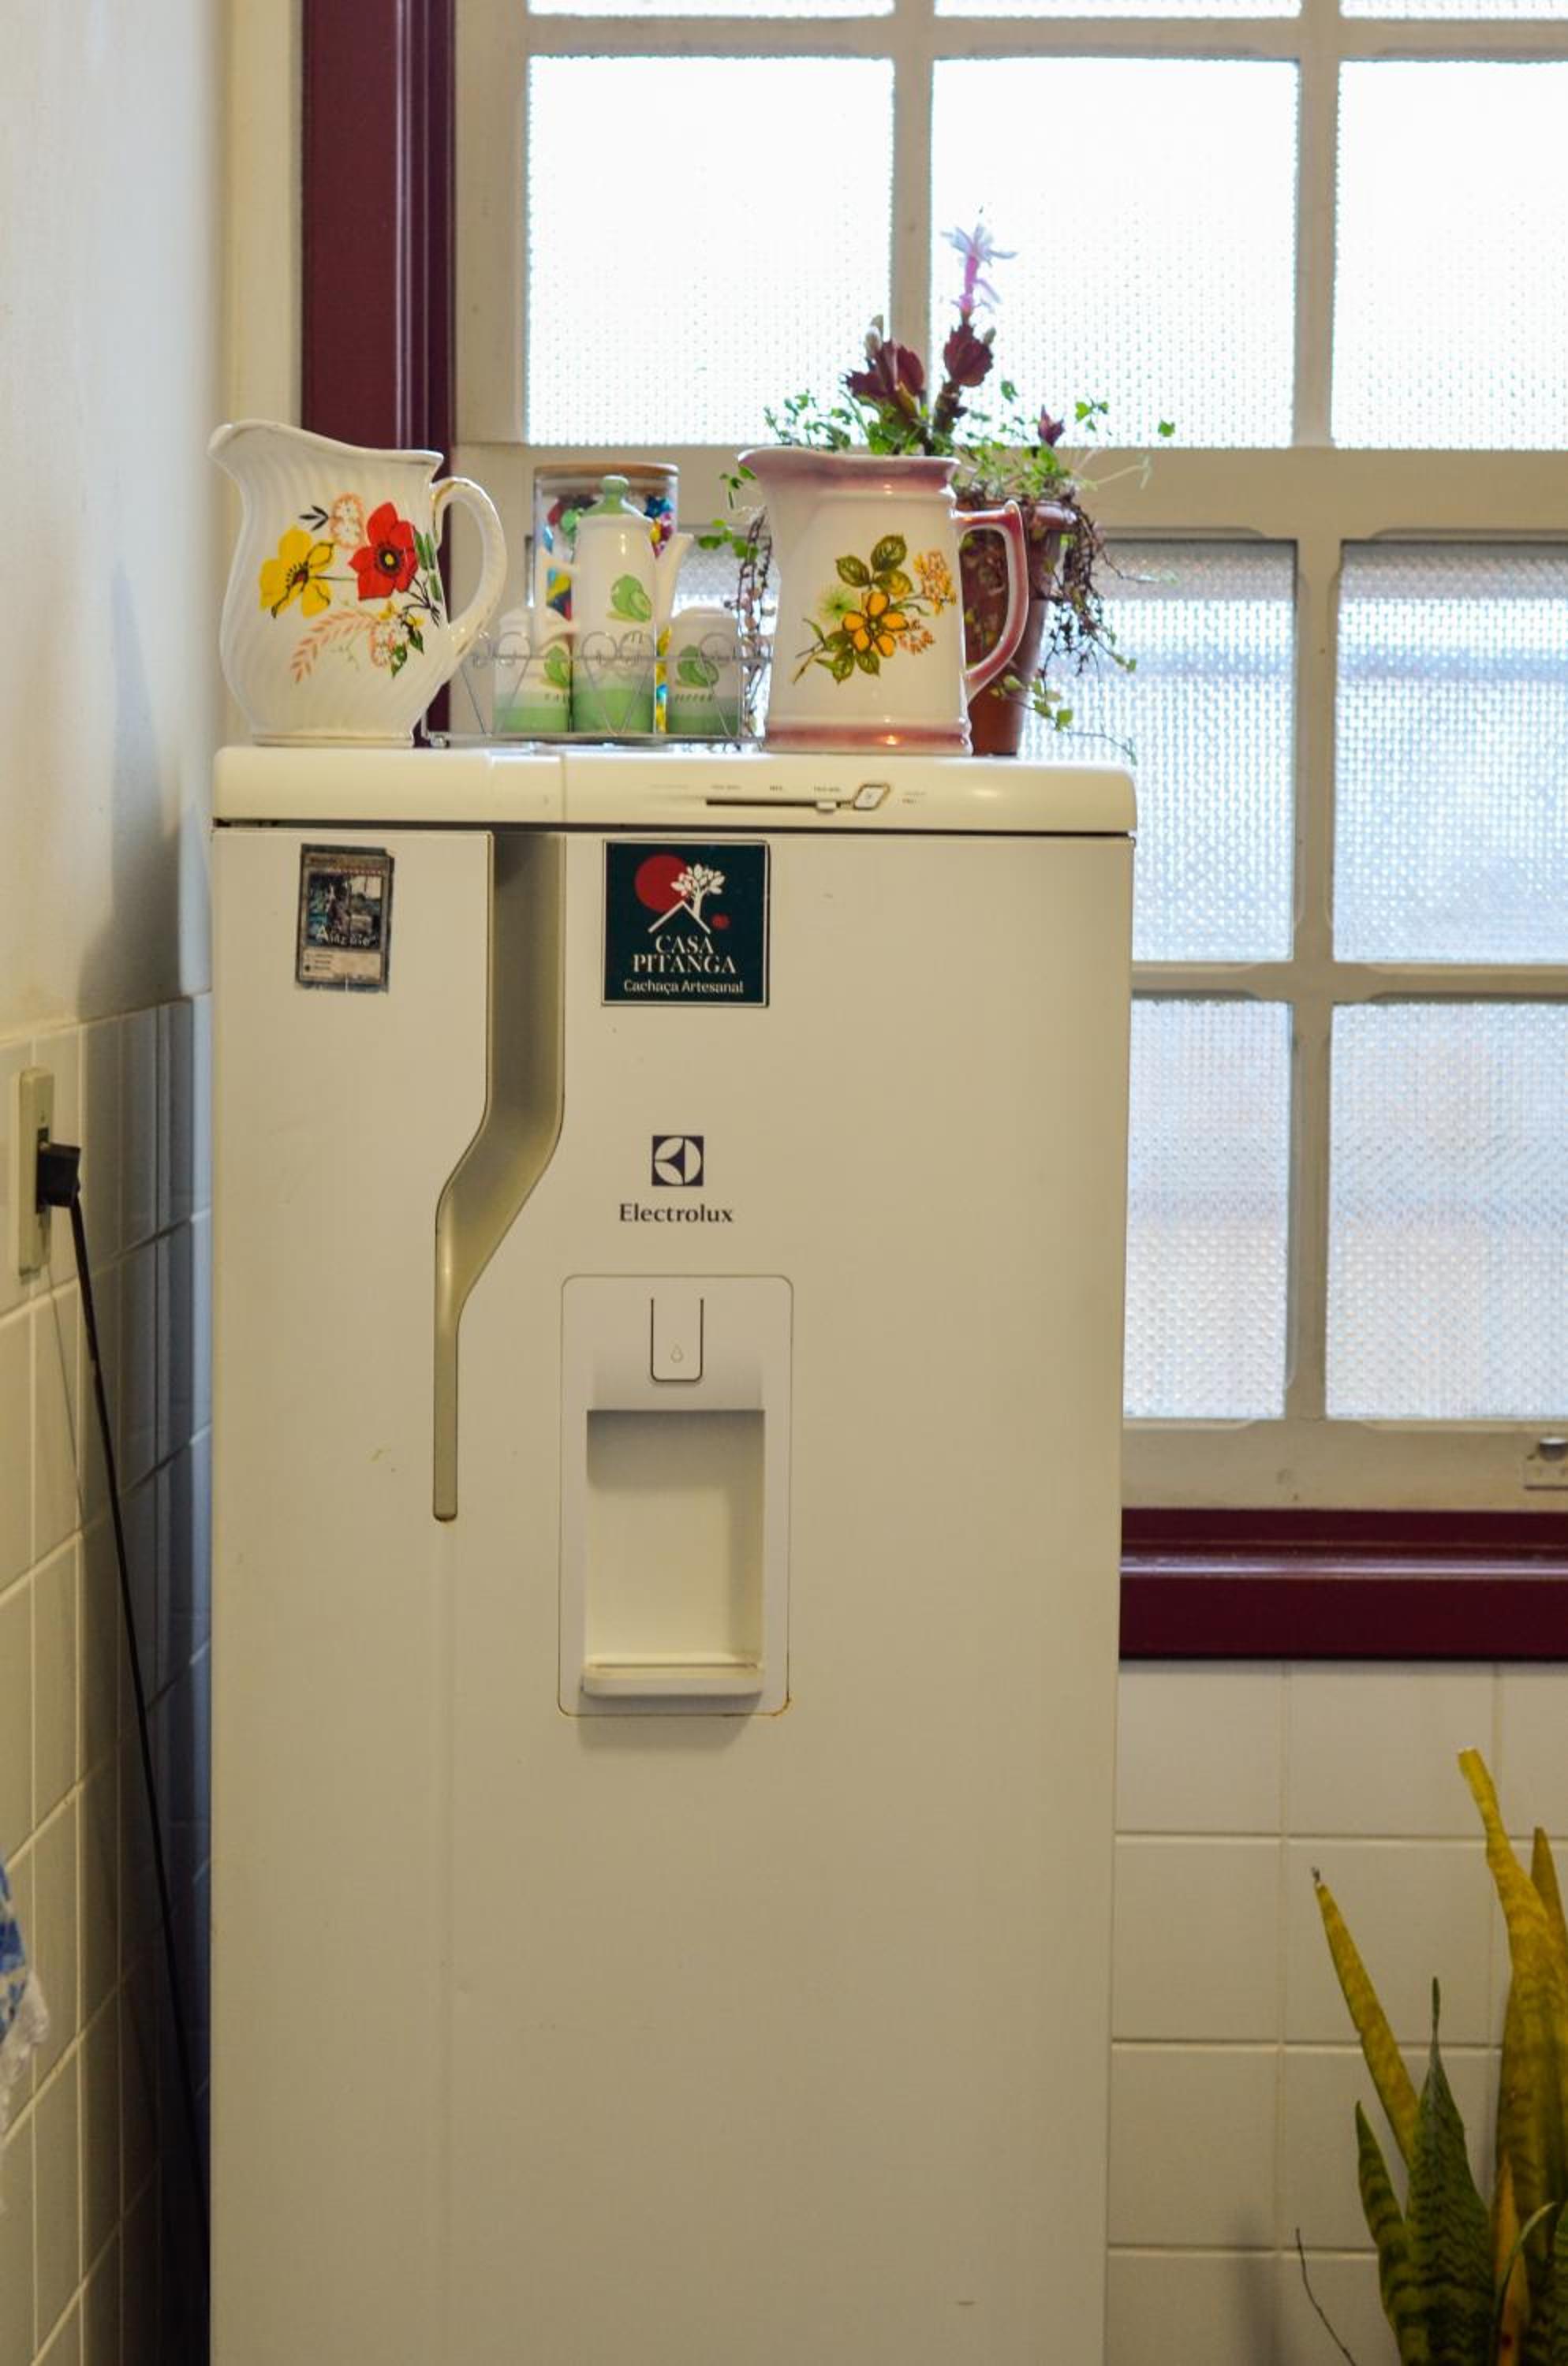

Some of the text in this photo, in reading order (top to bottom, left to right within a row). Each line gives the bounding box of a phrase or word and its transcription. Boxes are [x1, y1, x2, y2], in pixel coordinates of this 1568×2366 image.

[655, 935, 714, 953] CASA
[633, 953, 737, 973] PITANGA
[624, 980, 744, 994] Cachaça Artesanal
[619, 1203, 733, 1222] Electrolux
